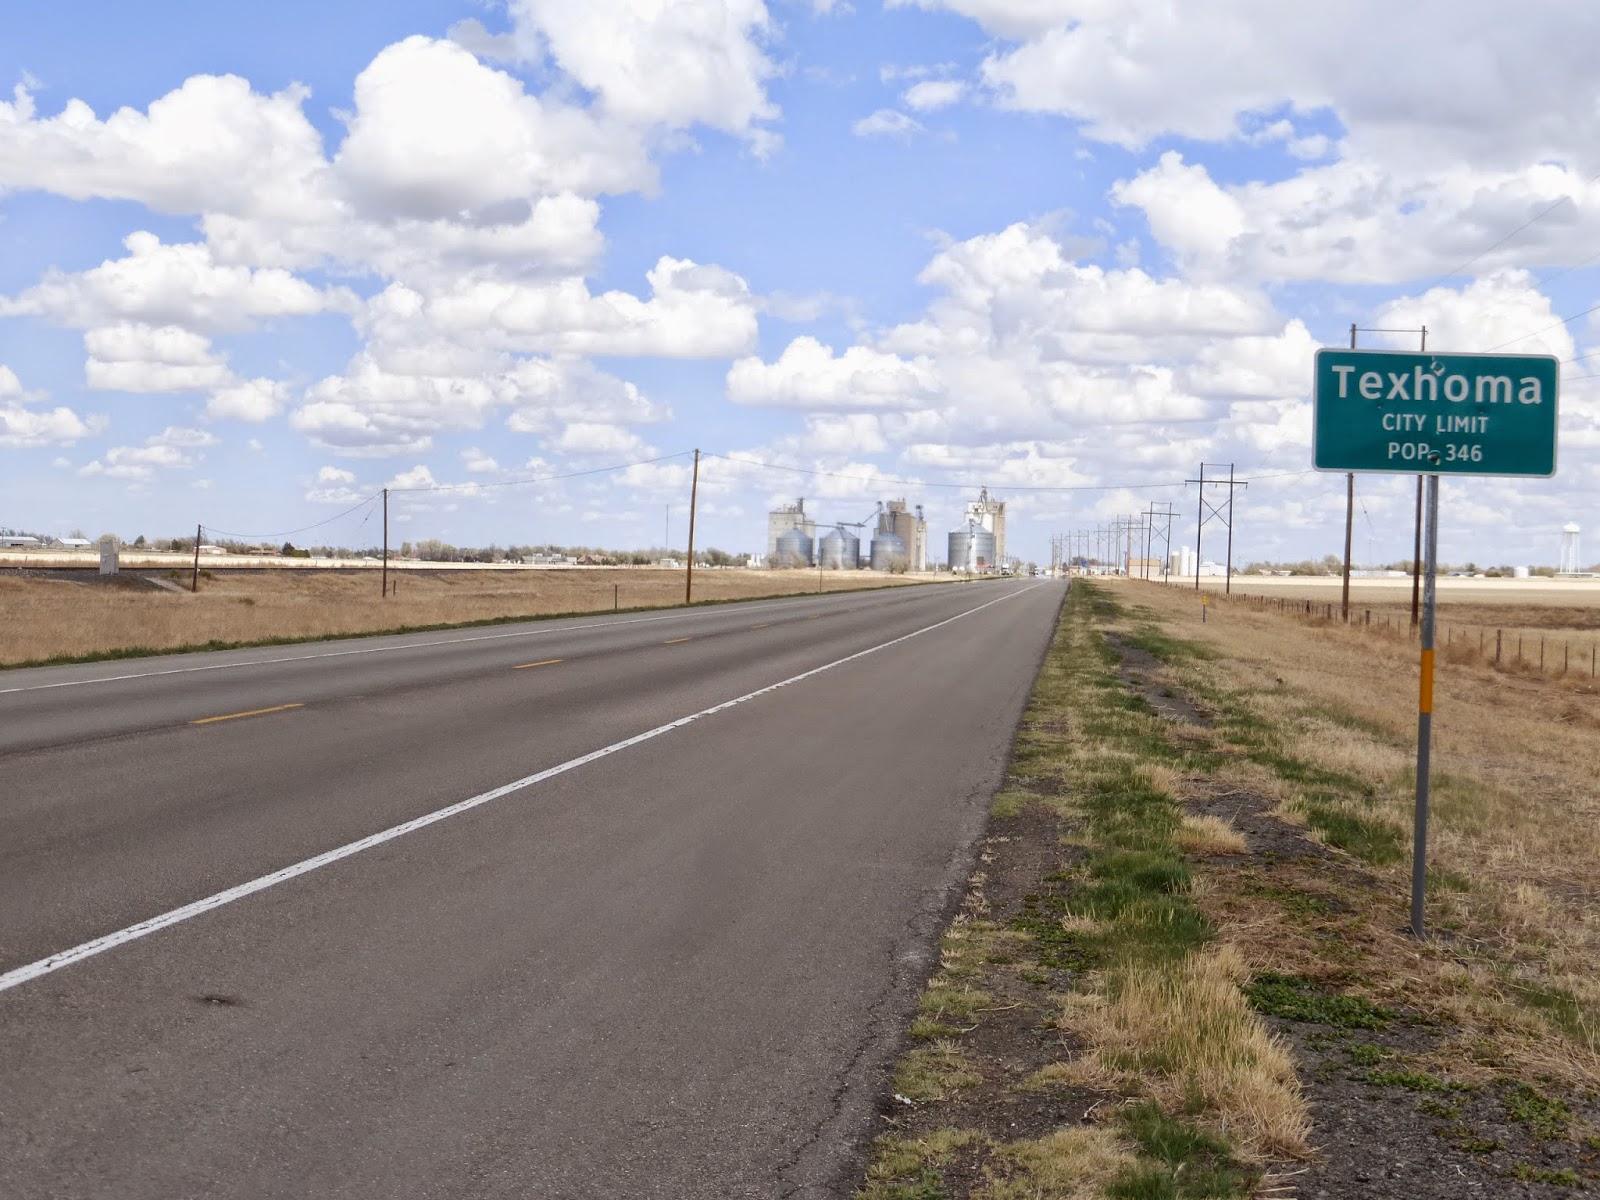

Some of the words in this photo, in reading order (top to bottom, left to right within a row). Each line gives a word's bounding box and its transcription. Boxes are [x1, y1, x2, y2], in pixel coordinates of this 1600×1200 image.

[1331, 365, 1543, 404] Texhoma
[1382, 413, 1427, 431] CITY
[1436, 415, 1489, 433] LIMIT
[1445, 443, 1483, 462] 346
